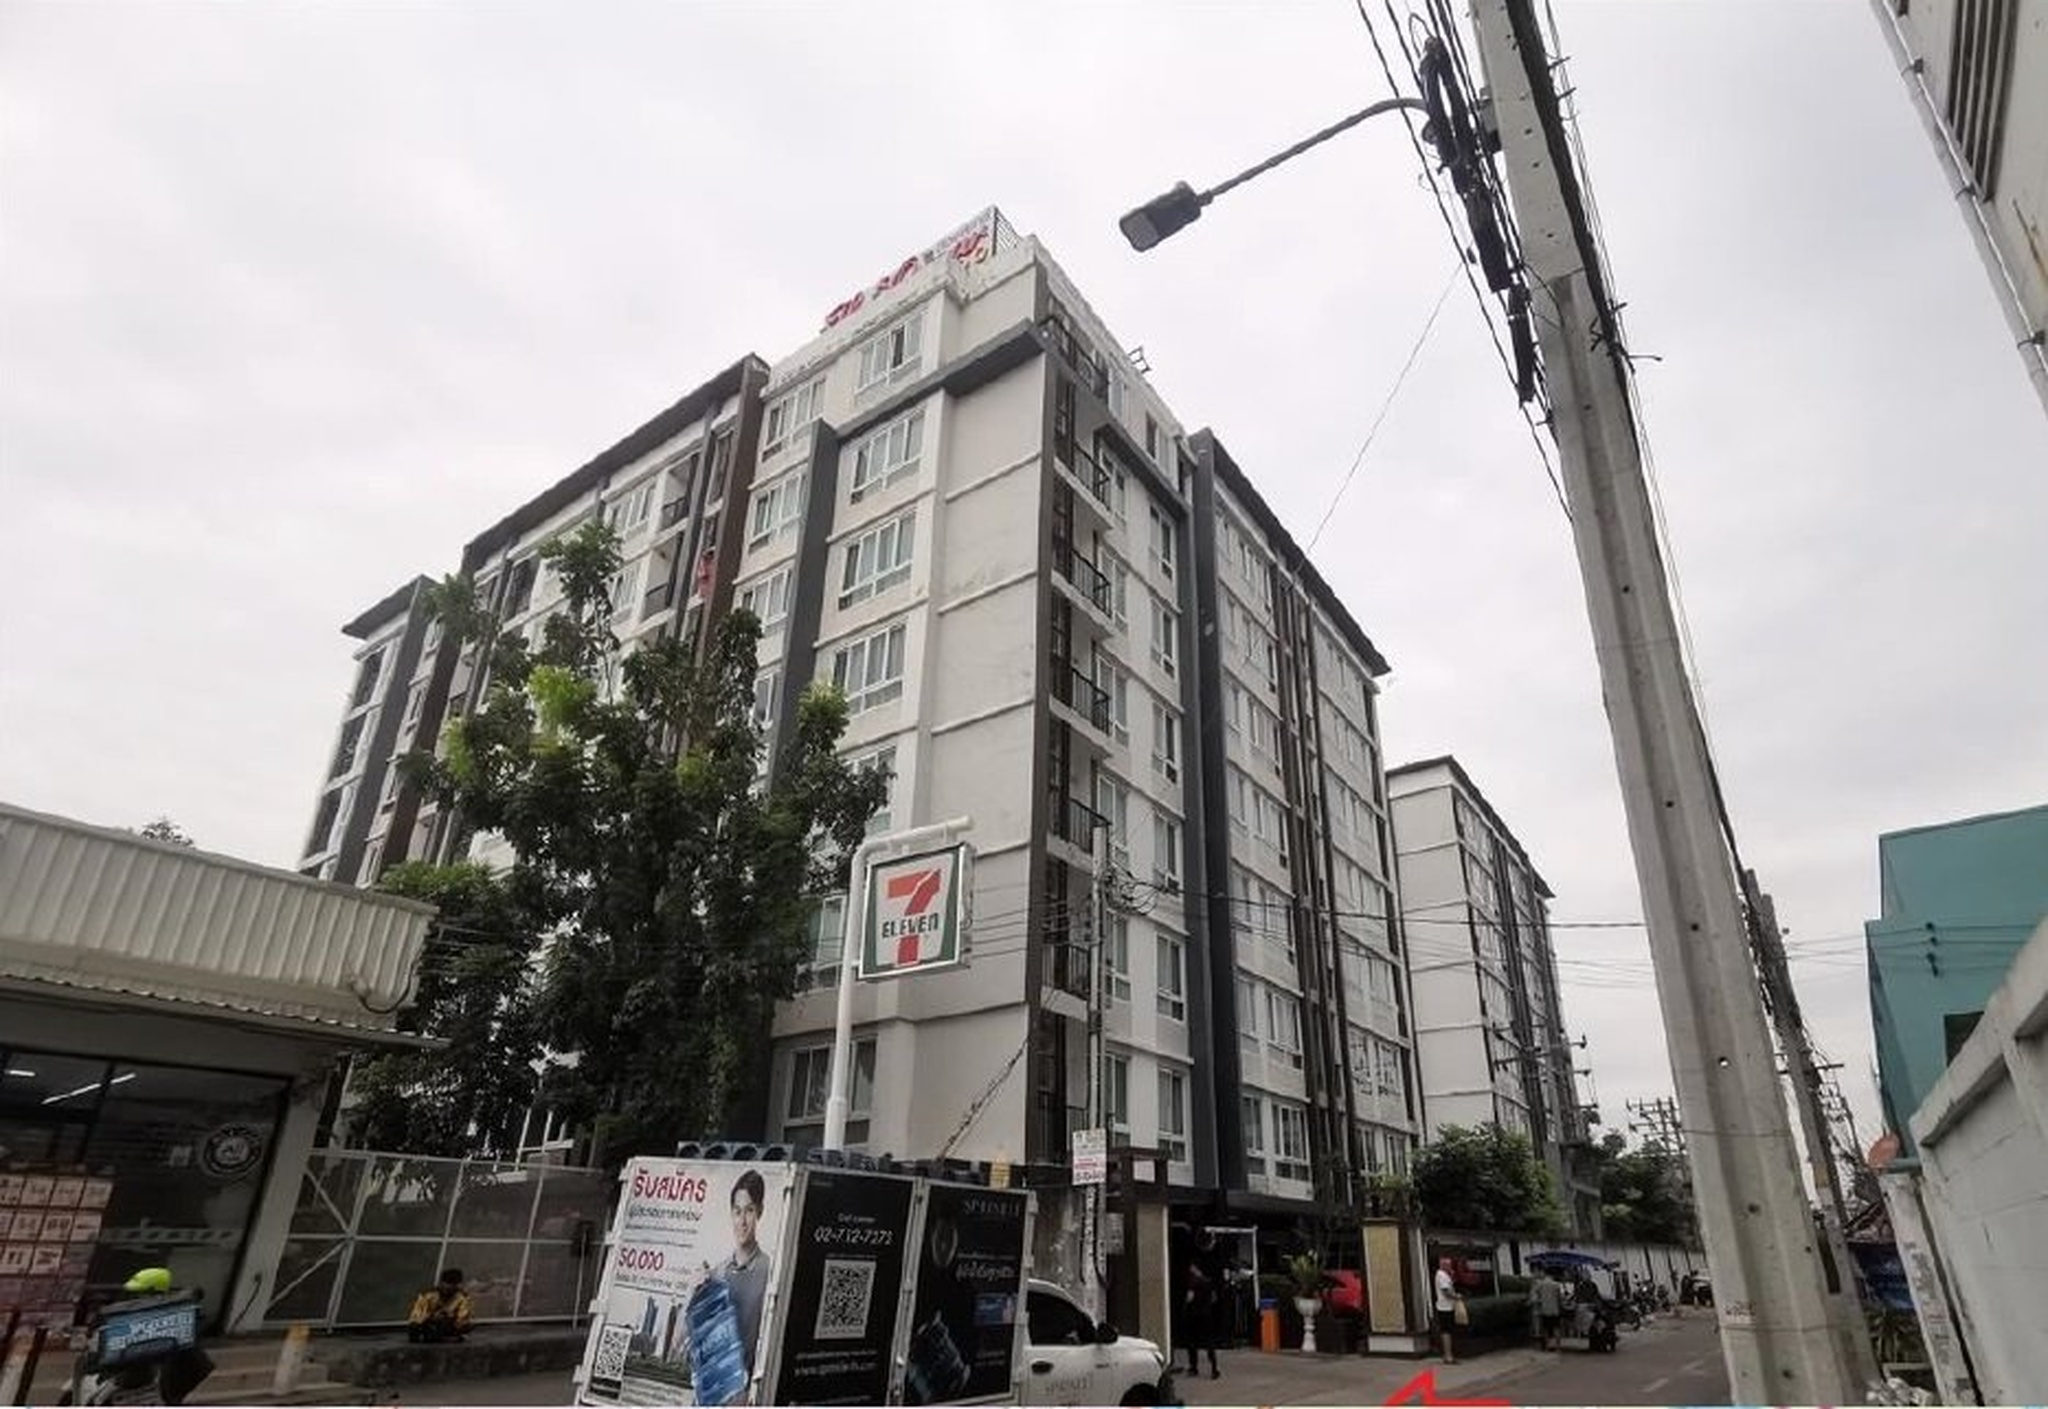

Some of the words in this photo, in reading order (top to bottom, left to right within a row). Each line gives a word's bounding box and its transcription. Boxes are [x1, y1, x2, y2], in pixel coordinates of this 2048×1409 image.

[887, 869, 941, 965] 7
[633, 1167, 708, 1203] รับสมัคร
